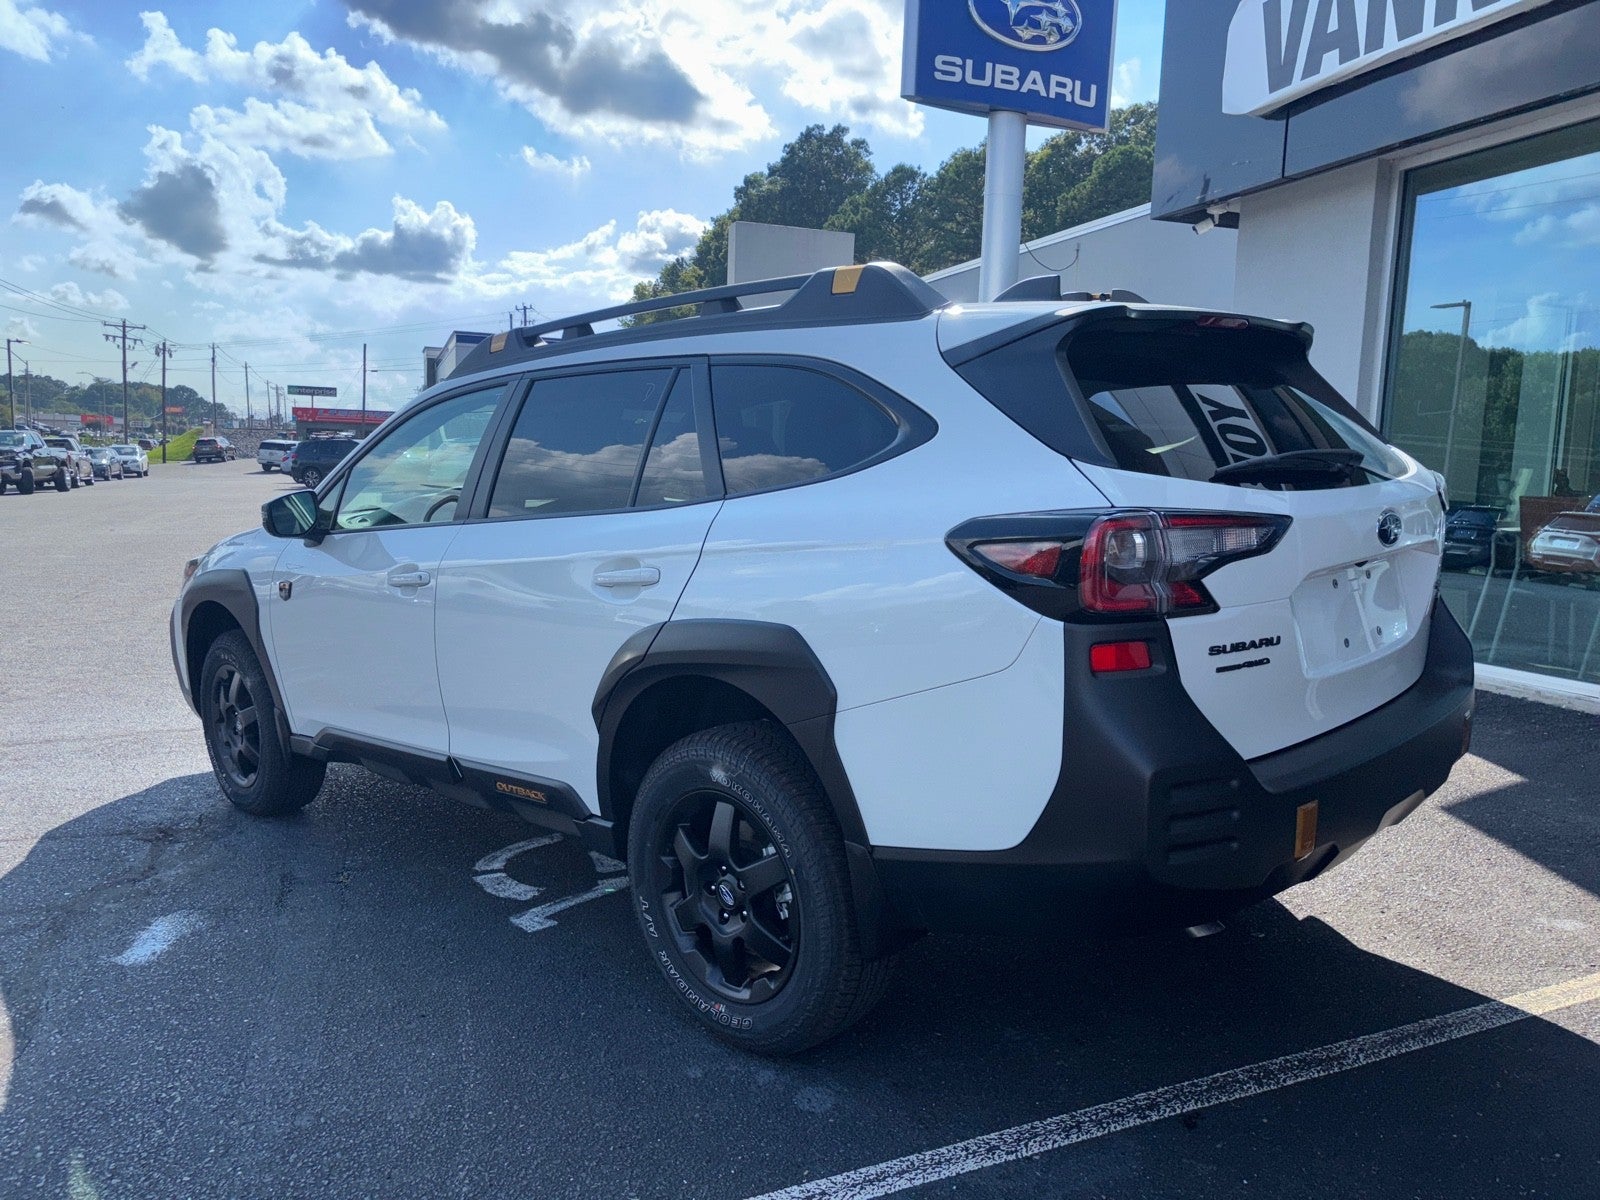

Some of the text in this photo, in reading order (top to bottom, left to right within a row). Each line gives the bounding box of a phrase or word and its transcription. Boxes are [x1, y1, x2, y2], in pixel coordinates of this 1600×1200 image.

[934, 54, 1097, 108] SUBARU
[290, 387, 336, 396] enterprise
[1208, 635, 1281, 656] SUBARU
[496, 781, 547, 802] OUTBACK
[709, 770, 792, 858] YOKOHAMA
[658, 949, 753, 1030] GEOLANDAR
